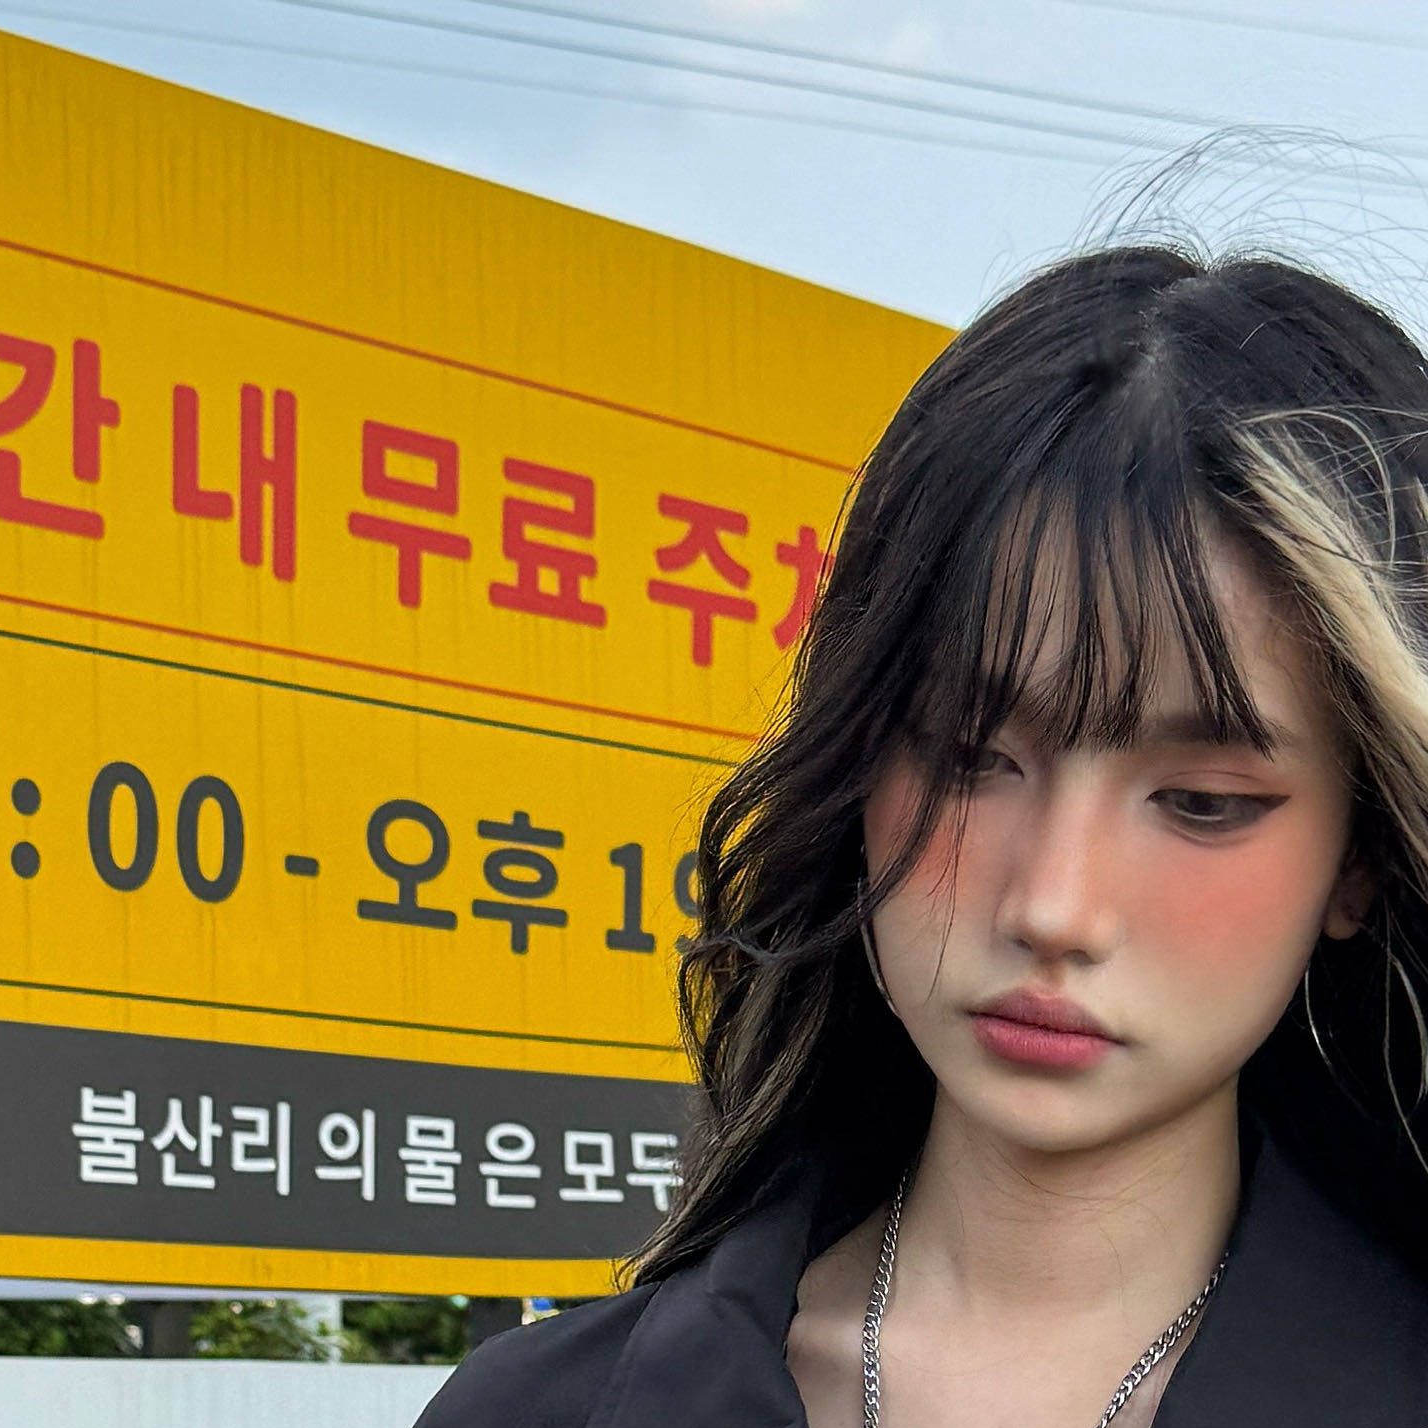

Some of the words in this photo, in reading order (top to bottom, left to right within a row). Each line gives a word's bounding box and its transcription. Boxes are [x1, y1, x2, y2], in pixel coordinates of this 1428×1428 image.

[173, 383, 297, 582] 내
[348, 420, 606, 627] 무료
[357, 799, 568, 955] 오후
